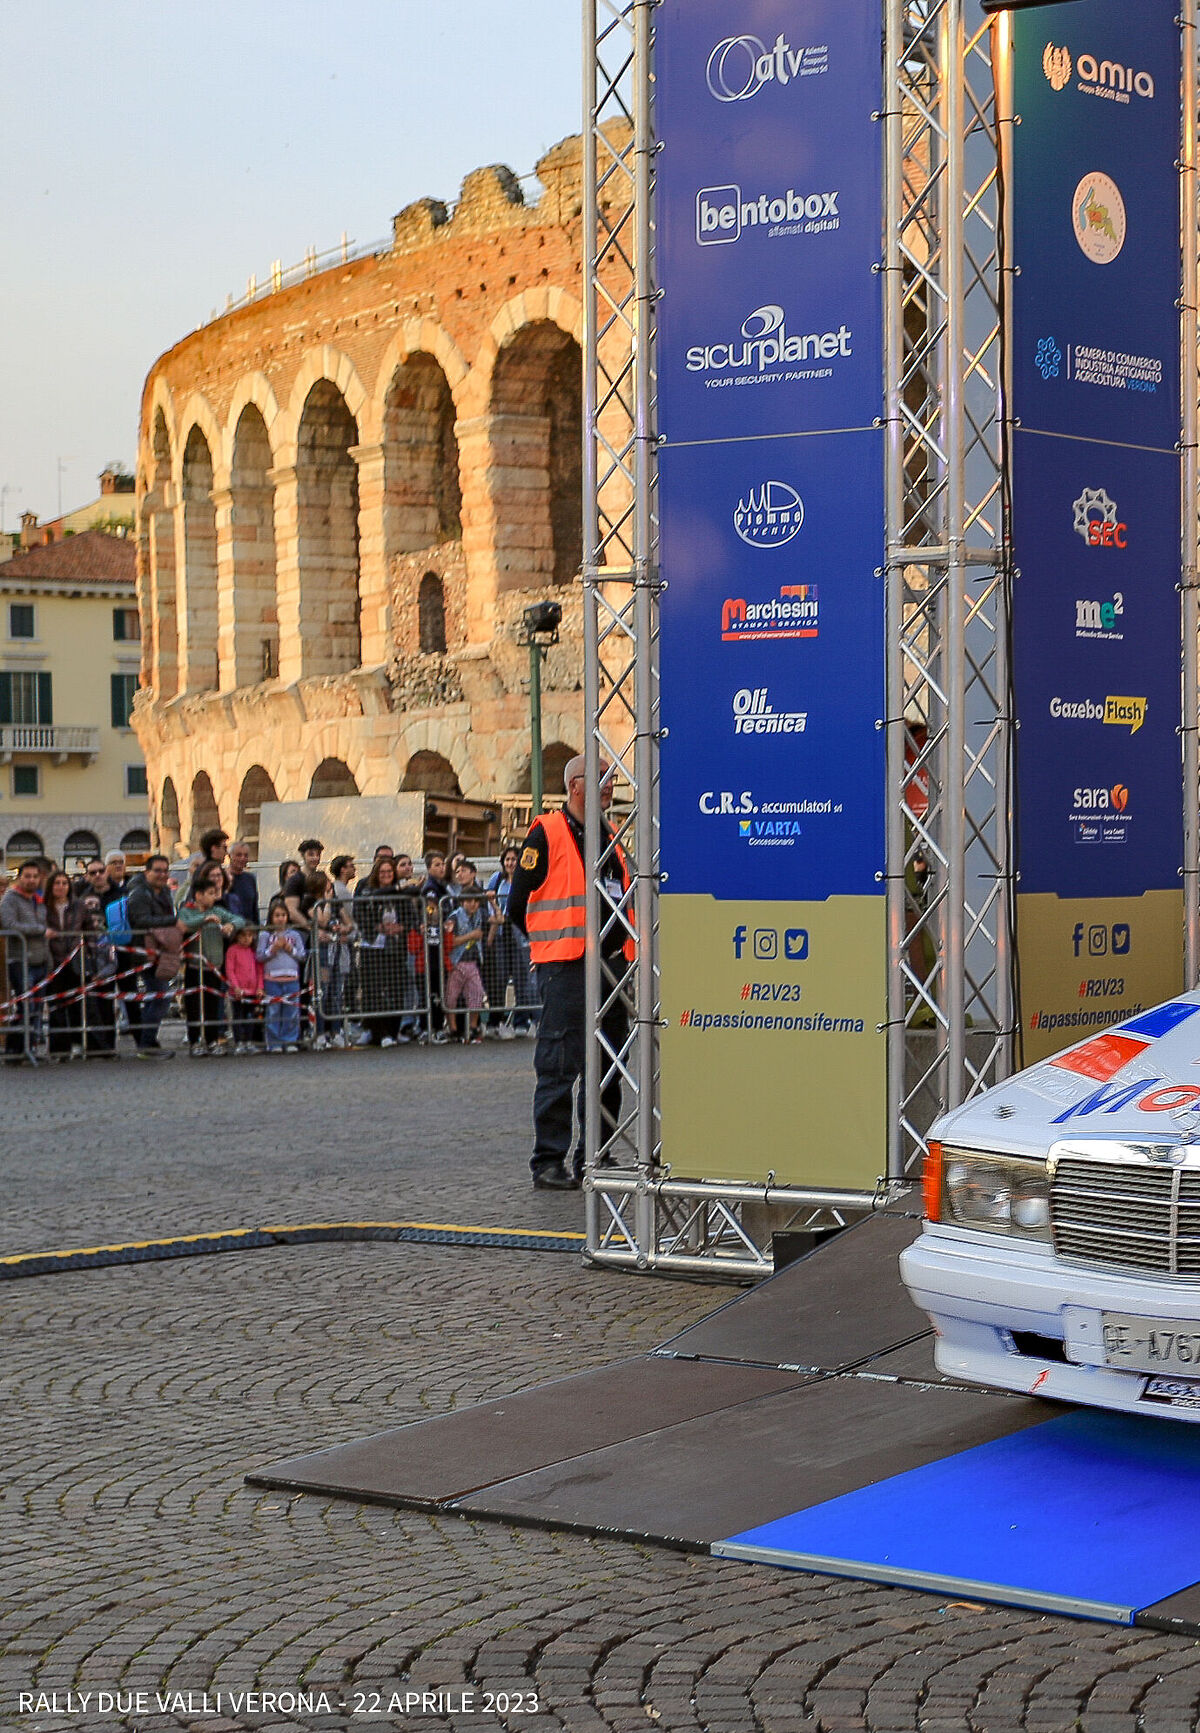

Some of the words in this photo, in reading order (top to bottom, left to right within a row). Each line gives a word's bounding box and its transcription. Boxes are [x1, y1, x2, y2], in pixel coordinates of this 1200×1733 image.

[756, 33, 805, 85] atv
[1077, 54, 1154, 98] amia
[701, 189, 839, 232] bentobox
[686, 323, 852, 372] sicurplanet
[1075, 345, 1107, 362] CAMERA
[1107, 351, 1116, 363] DI
[1117, 353, 1162, 371] COMMERCIO
[705, 377, 734, 389] YOUR
[734, 374, 784, 386] SECURITY
[785, 368, 833, 381] PARTNER
[1075, 358, 1114, 374] INDUSTRIA
[1115, 365, 1162, 383] ARTIGIANATO
[1075, 370, 1126, 388] AGRICOLTURA
[1089, 520, 1127, 549] SEC
[722, 598, 818, 630] Marchesini
[732, 621, 768, 629] STAMPA
[733, 688, 772, 714] Oli.
[734, 713, 808, 734] Tecnica
[699, 791, 758, 814] C.R.S.
[761, 799, 831, 814] accumulatori
[1073, 787, 1109, 809] sara
[755, 821, 801, 836] VARTA
[740, 983, 801, 1002] #R2V23
[1078, 978, 1125, 998] #R2V23
[679, 1009, 865, 1033] #lapassionenonsiferma
